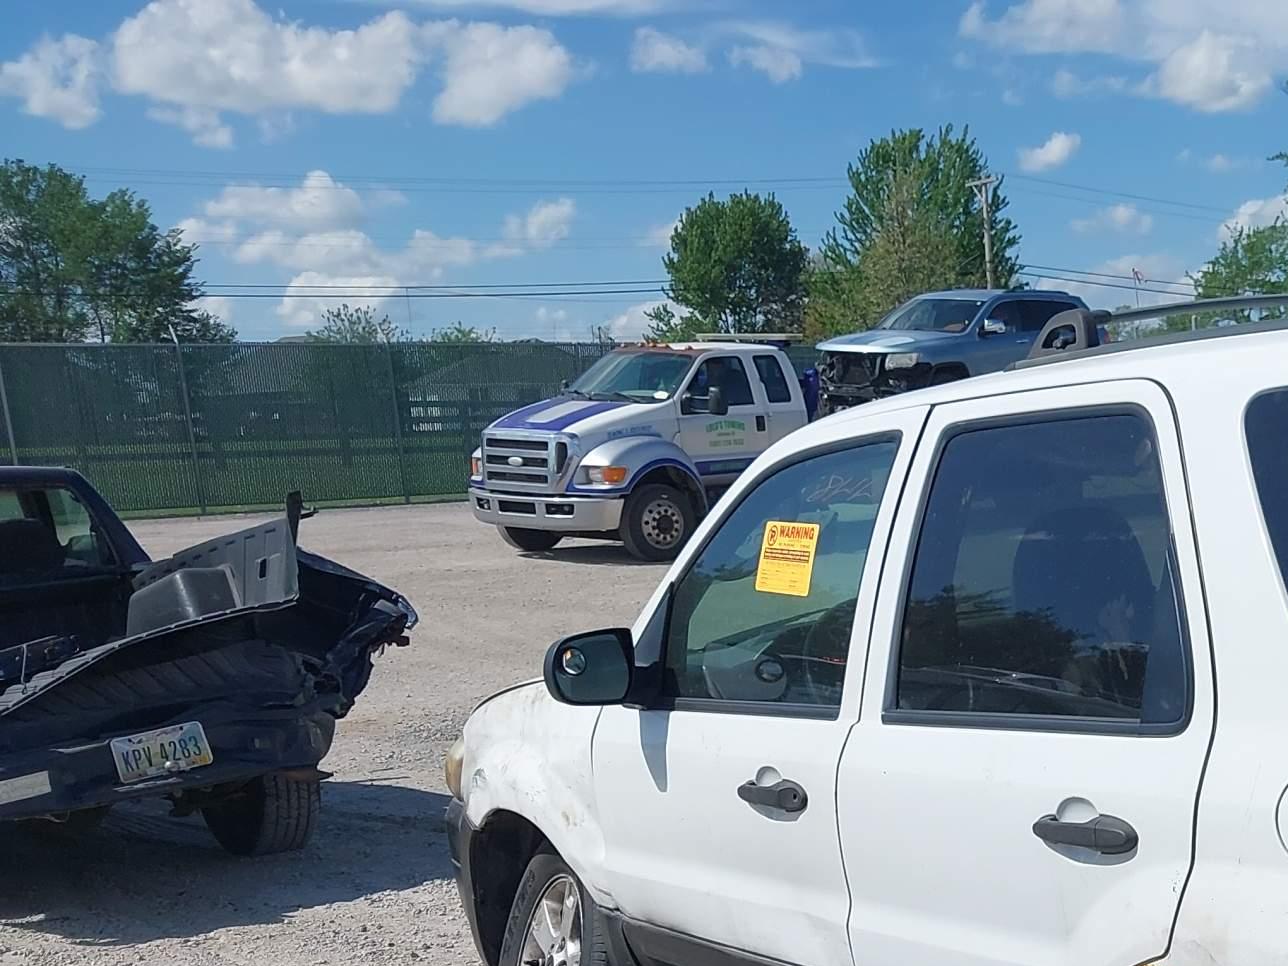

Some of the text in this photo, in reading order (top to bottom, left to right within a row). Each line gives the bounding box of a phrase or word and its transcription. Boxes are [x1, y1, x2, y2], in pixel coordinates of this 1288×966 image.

[779, 525, 815, 540] WARNING
[121, 735, 202, 773] KPV 4283
